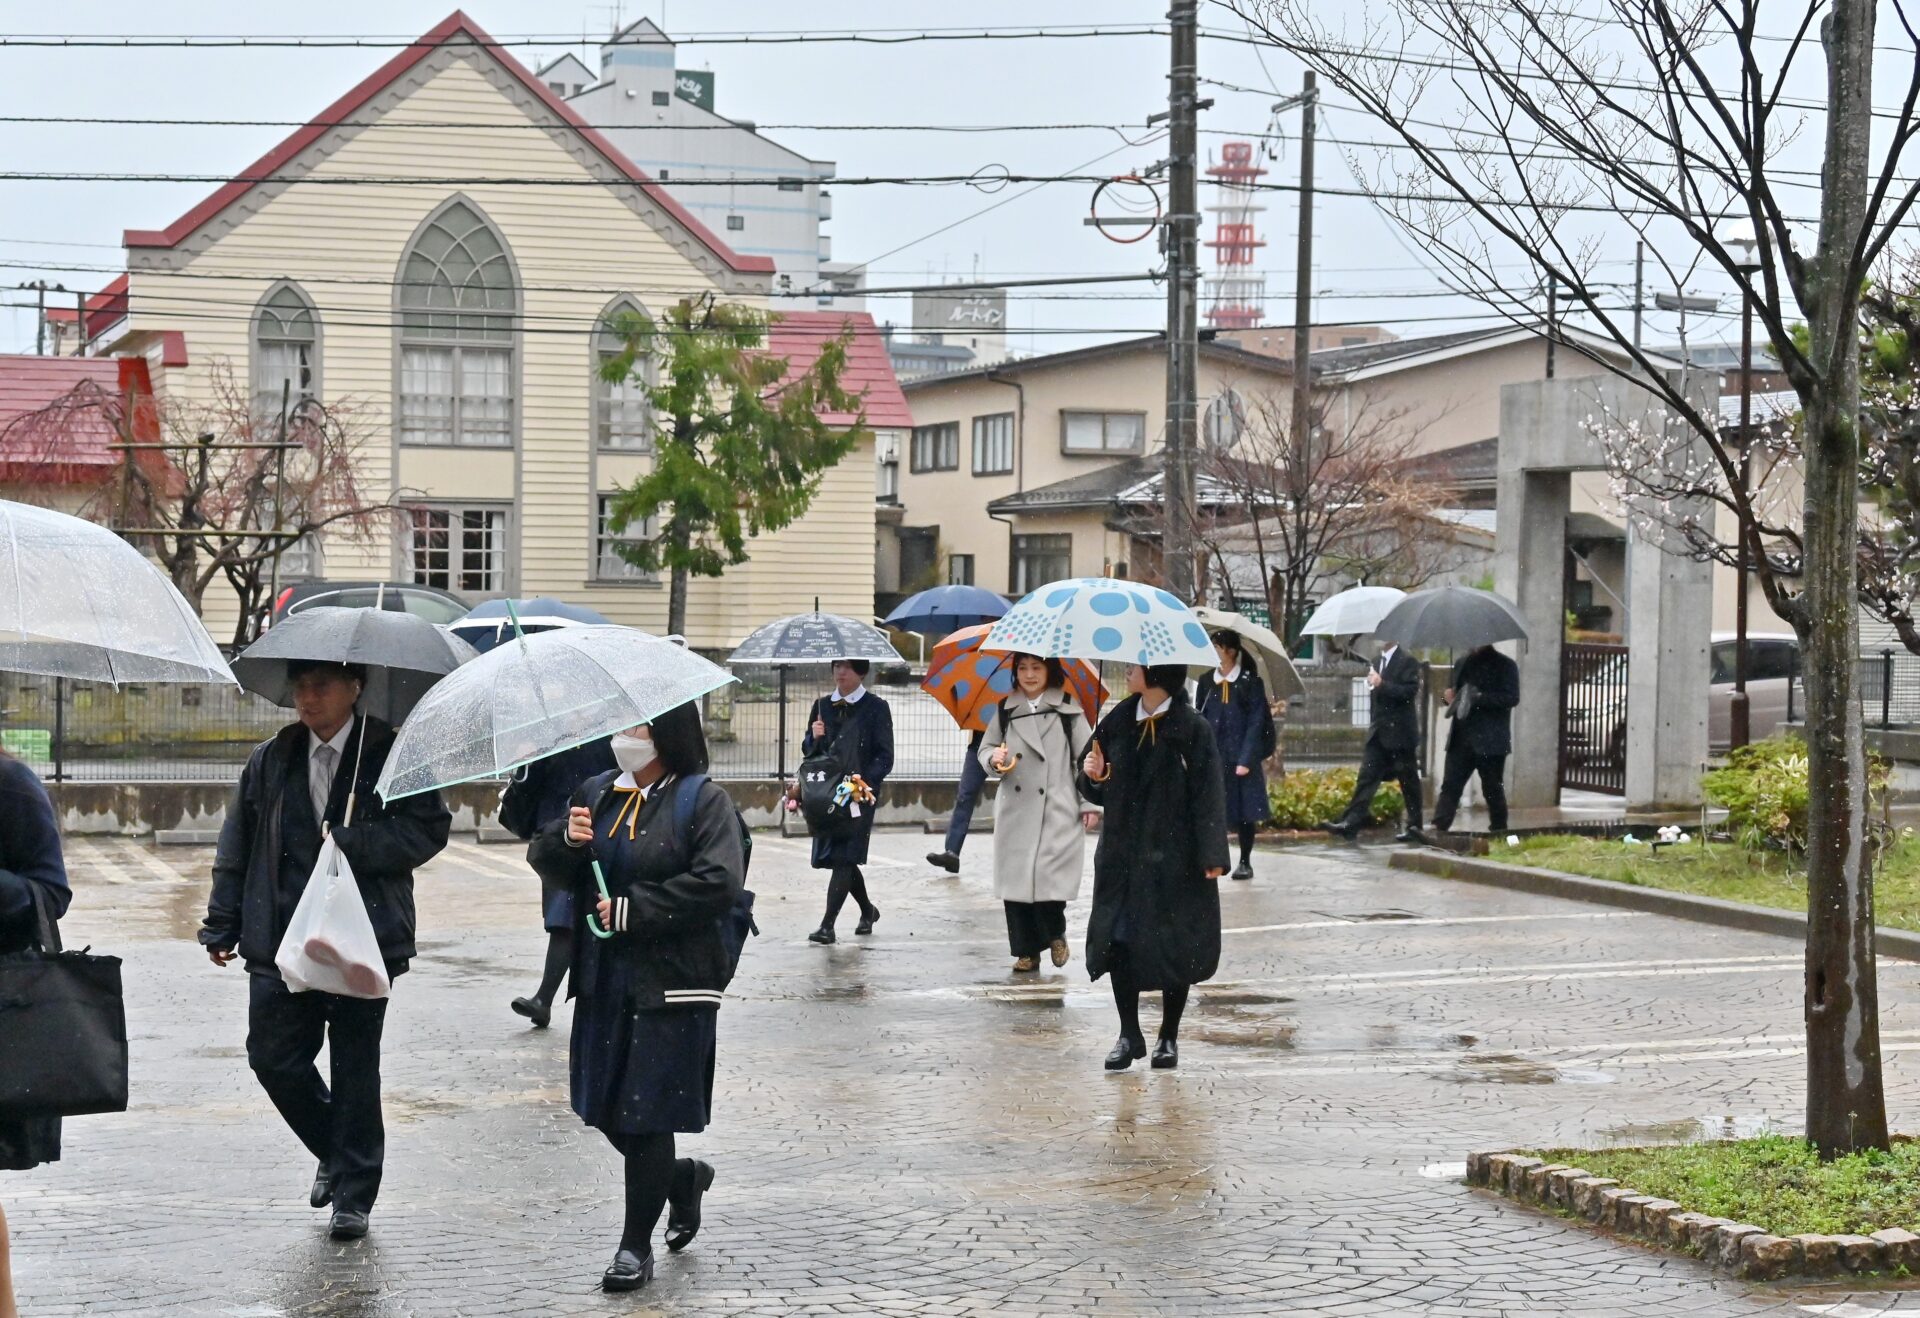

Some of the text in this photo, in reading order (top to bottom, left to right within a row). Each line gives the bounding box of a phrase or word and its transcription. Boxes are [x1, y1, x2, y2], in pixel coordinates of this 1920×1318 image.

[948, 306, 1004, 323] ルートイン
